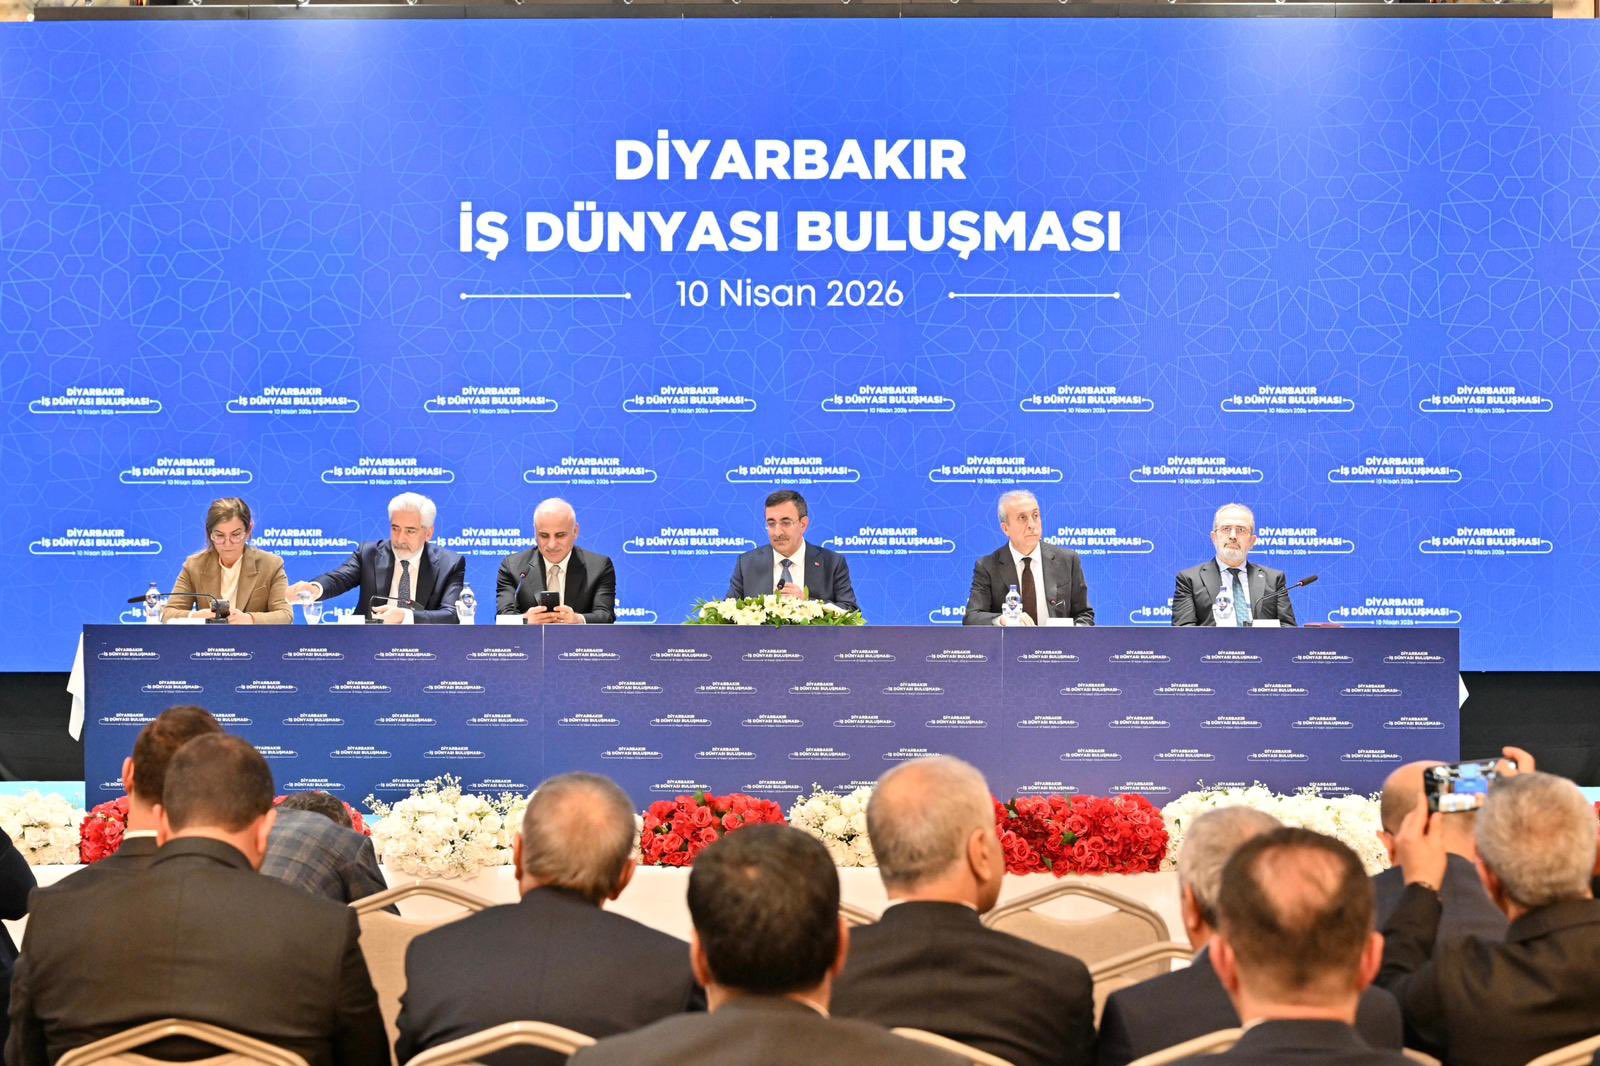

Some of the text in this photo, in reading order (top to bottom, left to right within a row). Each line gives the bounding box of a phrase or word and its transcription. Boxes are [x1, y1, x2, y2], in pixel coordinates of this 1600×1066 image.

[616, 130, 966, 179] DİYARBAKIR
[460, 202, 1120, 260] İŞ DÜNYASI BULUŞMASI
[677, 279, 903, 306] 10 Nisan 2026
[66, 386, 124, 396] DİYARBAKIR
[264, 386, 322, 396] DİYARBAKIR
[462, 385, 520, 395] DİYARBAKIR
[660, 385, 718, 395] DİYARBAKIR
[859, 384, 917, 394] DİYARBAKIR
[1058, 385, 1116, 394] DİYARBAKIR
[1259, 385, 1317, 394] DİYARBAKIR
[1457, 385, 1515, 395] DİYARBAKIR
[41, 396, 150, 407] İŞ DÜNYASI BULUŞMASI
[239, 396, 347, 406] İŞ DÜNYASI BULUŞMASI
[437, 395, 545, 406] İŞ DÜNYASI BULUŞMASI
[636, 395, 744, 405] İŞ DÜNYASI BULUŞMASI
[834, 394, 942, 405] İŞ DÜNYASI BULUŞMASI
[1033, 395, 1141, 405] İŞ DÜNYASI BULUŞMASI
[1234, 395, 1342, 405] İŞ DÜNYASI BULUŞMASI
[1432, 395, 1540, 405] İŞ DÜNYASI BULUŞMASI
[157, 456, 215, 466] DİYARBAKIR
[359, 456, 417, 466] DİYARBAKIR
[561, 456, 619, 466] DİYARBAKIR
[764, 455, 822, 465] DİYARBAKIR
[967, 455, 1025, 465] DİYARBAKIR
[1168, 455, 1226, 465] DİYARBAKIR
[1366, 456, 1424, 466] DİYARBAKIR
[132, 466, 240, 477] İŞ DÜNYASI BULUŞMASI
[334, 466, 442, 477] İŞ DÜNYASI BULUŞMASI
[536, 466, 644, 476] İŞ DÜNYASI BULUŞMASI
[739, 465, 847, 476] İŞ DÜNYASI BULUŞMASI
[942, 465, 1050, 476] İŞ DÜNYASI BULUŞMASI
[1142, 465, 1251, 476] İŞ DÜNYASI BULUŞMASI
[1341, 466, 1449, 476] İŞ DÜNYASI BULUŞMASI
[66, 527, 124, 537] DİYARBAKIR
[264, 527, 322, 537] DİYARBAKIR
[462, 527, 520, 536] DİYARBAKIR
[660, 526, 718, 536] DİYARBAKIR
[860, 526, 918, 536] DİYARBAKIR
[1058, 526, 1116, 536] DİYARBAKIR
[1259, 526, 1317, 536] DİYARBAKIR
[1457, 526, 1515, 536] DİYARBAKIR
[42, 537, 150, 548] İŞ DÜNYASI BULUŞMASI
[293, 538, 347, 547] BULUŞMASI
[437, 537, 538, 547] İŞ DÜNYASI BULUŞMA
[636, 536, 744, 547] İŞ DÜNYASI BULUŞMASI
[834, 536, 943, 546] İŞ DÜNYASI BULUŞMASI
[1088, 537, 1141, 546] BULUŞMASI
[1288, 537, 1342, 546] BULUŞMASI
[1432, 536, 1540, 547] İŞ DÜNYASI BULUŞMASI
[1366, 596, 1424, 606] DİYARBAKIR
[615, 608, 645, 616] ŞMASI
[942, 606, 950, 616] İŞ
[1142, 606, 1151, 616] İŞ
[1340, 606, 1449, 617] İŞ DÜNYASI BULUŞMASI
